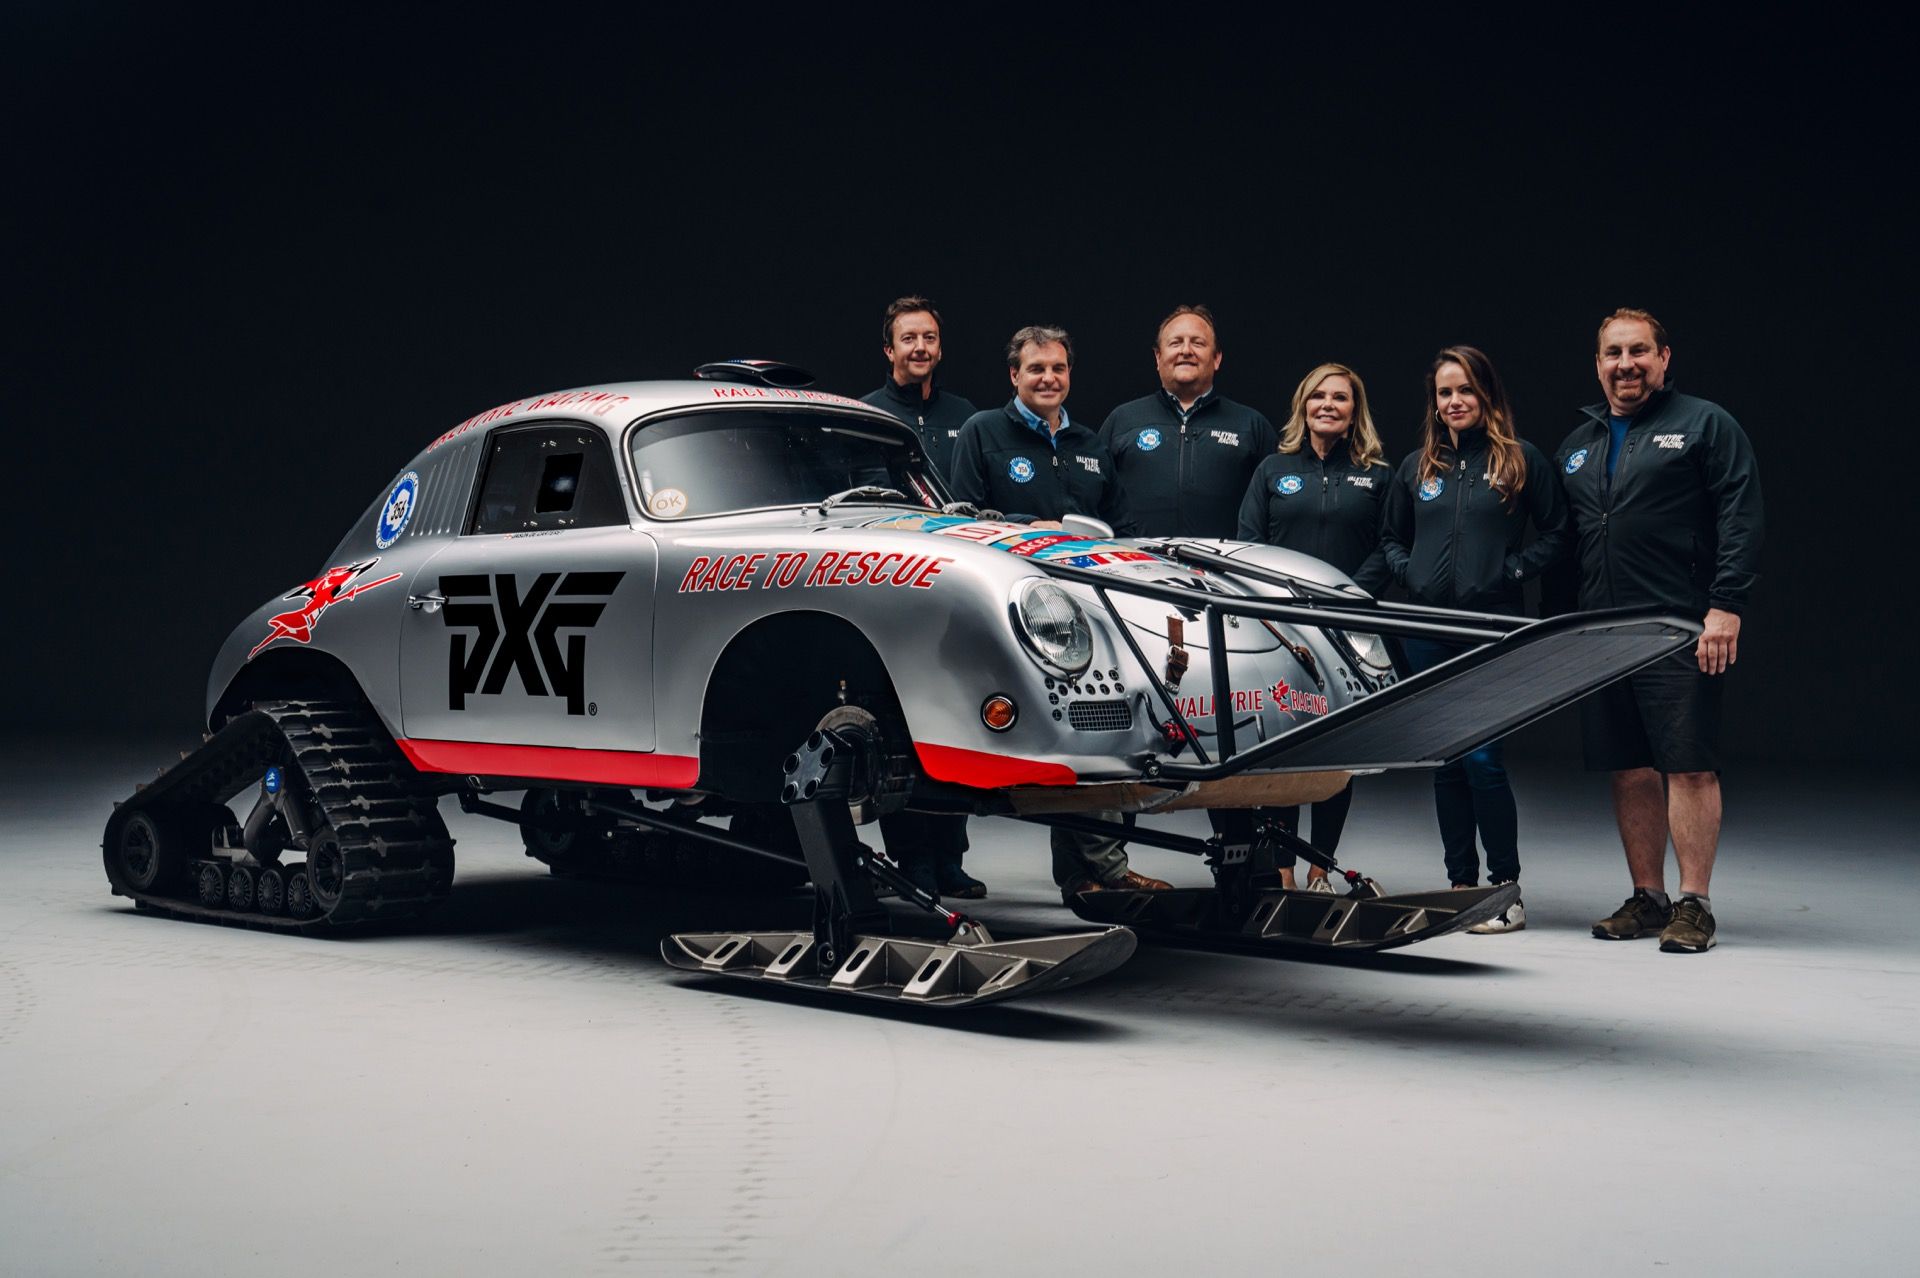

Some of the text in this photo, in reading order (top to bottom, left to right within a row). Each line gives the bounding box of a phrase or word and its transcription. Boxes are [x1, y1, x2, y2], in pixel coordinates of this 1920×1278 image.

[713, 387, 770, 399] RACE
[656, 495, 682, 510] OK
[678, 551, 956, 593] RACE TO RESCUE
[1175, 689, 1329, 719] VALRIE RACING
